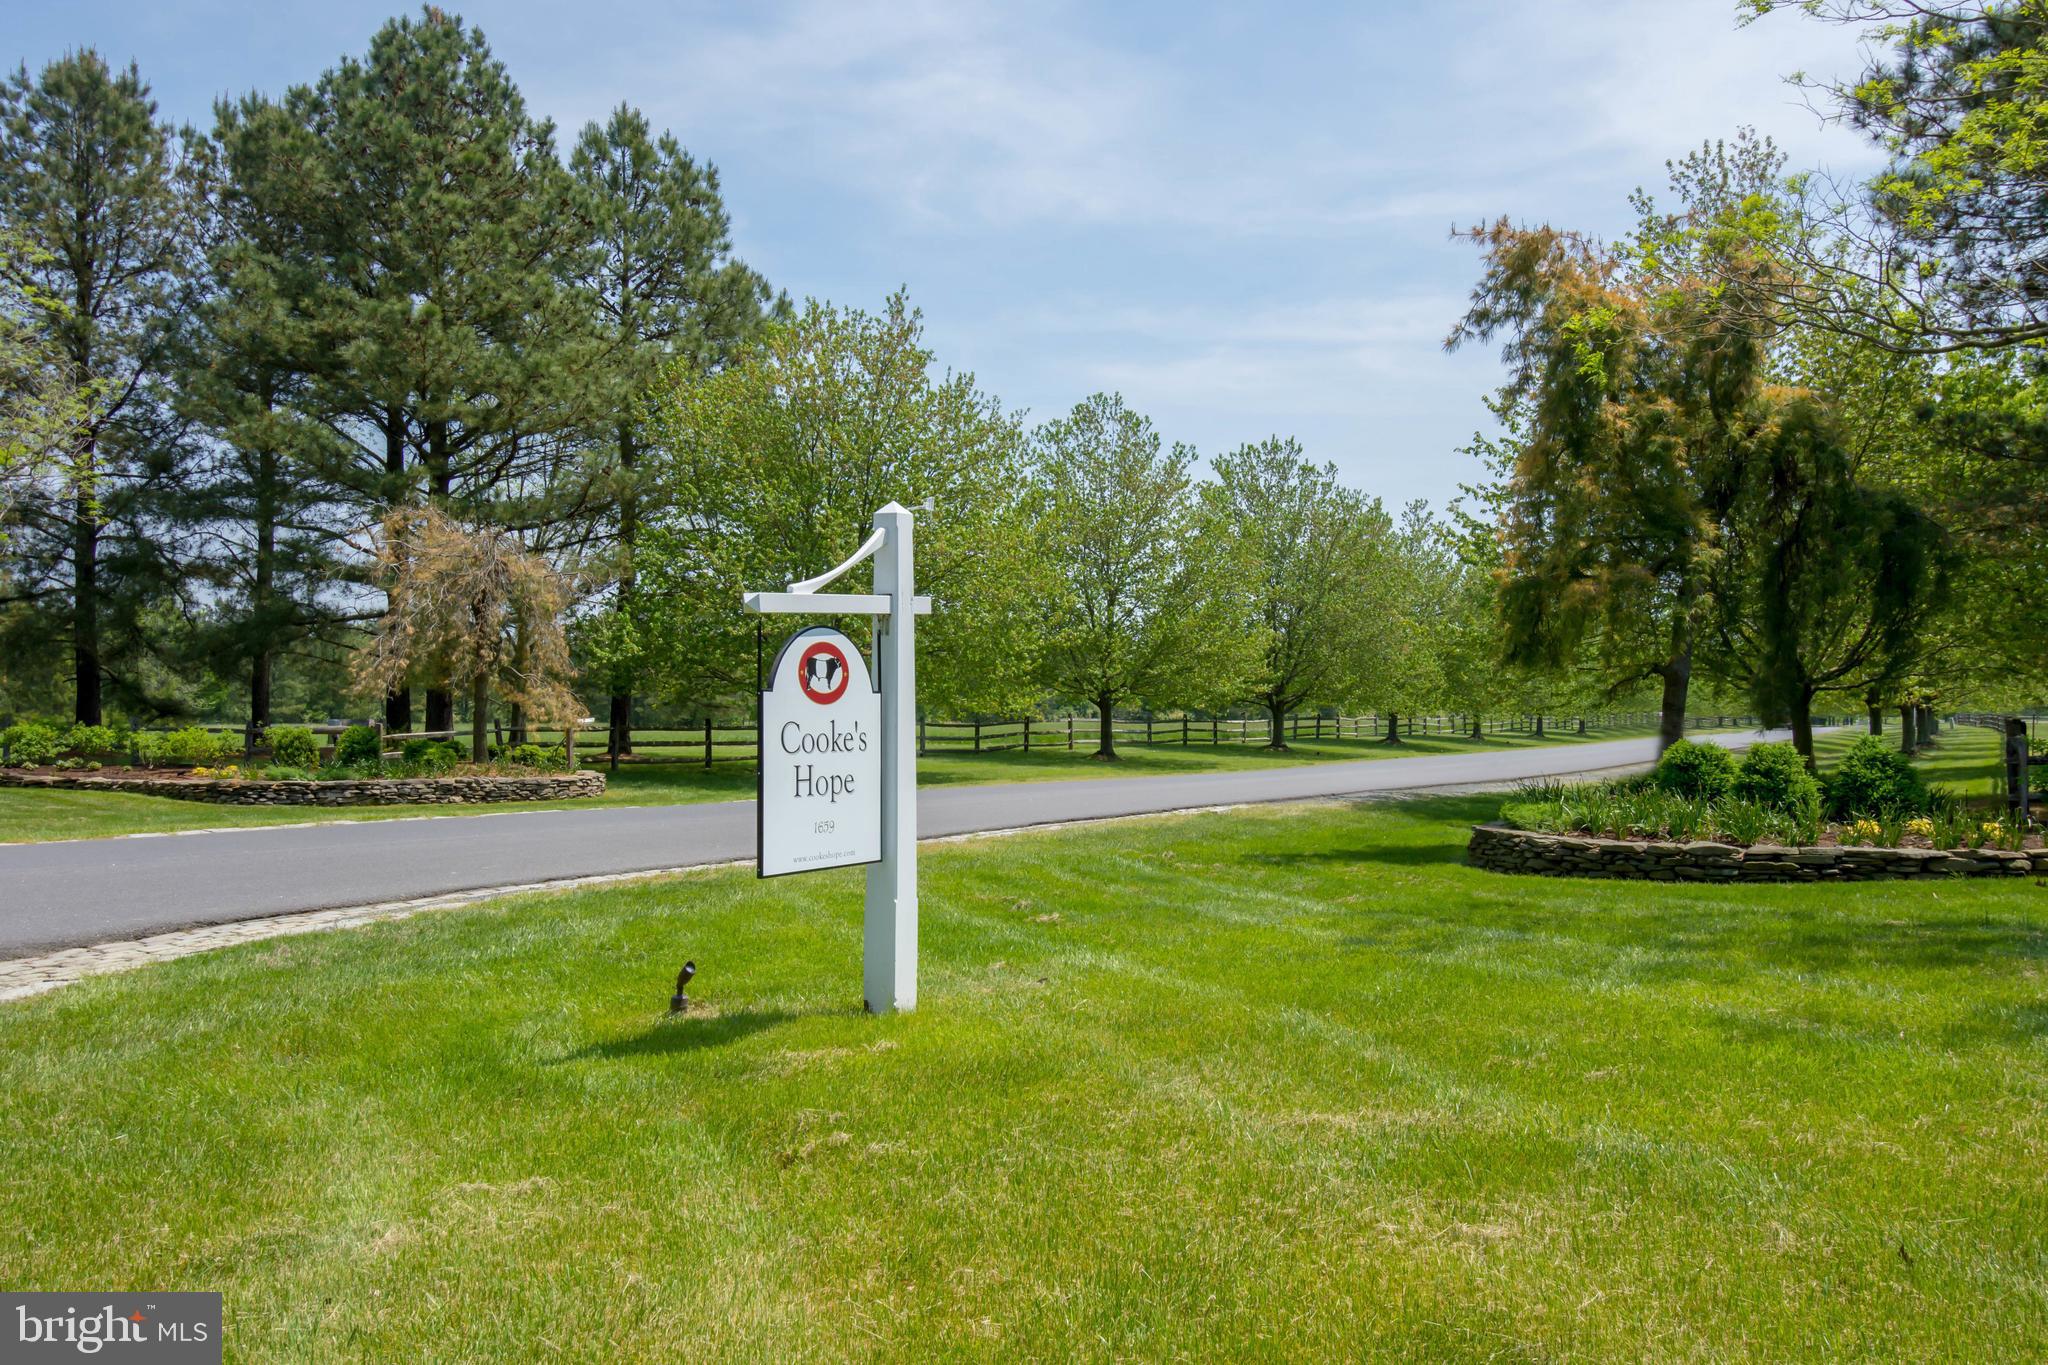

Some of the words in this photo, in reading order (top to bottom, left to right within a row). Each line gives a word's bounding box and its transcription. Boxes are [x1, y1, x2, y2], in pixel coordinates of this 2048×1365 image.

[780, 719, 868, 754] Cooke's
[793, 764, 855, 803] Hope
[813, 819, 836, 834] 1659
